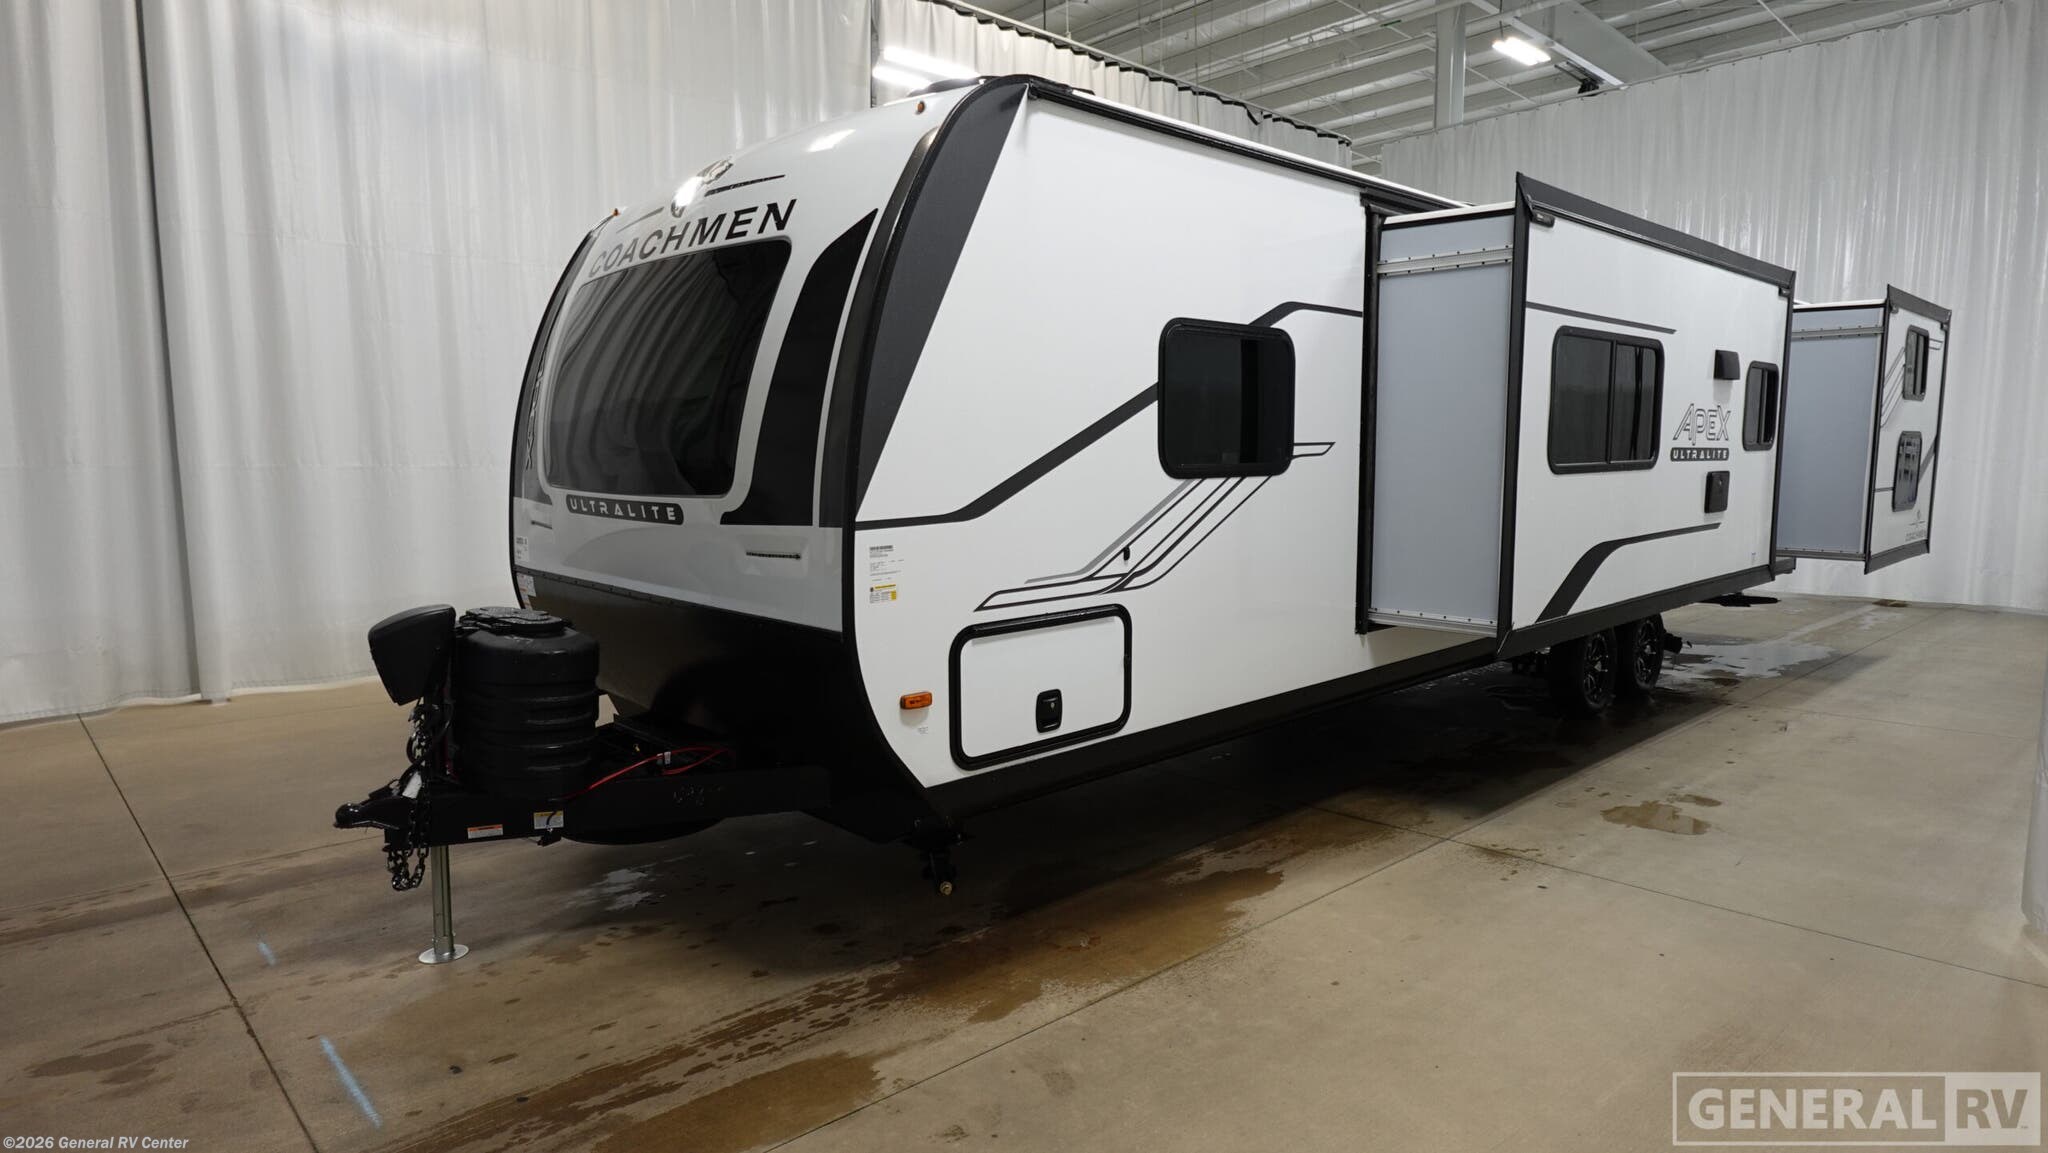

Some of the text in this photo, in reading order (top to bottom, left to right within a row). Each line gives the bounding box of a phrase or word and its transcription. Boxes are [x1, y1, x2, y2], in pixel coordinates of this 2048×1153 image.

[588, 198, 797, 278] COACHMEN
[1672, 449, 1728, 460] ULTRALITE
[569, 498, 677, 521] ULTRALITE
